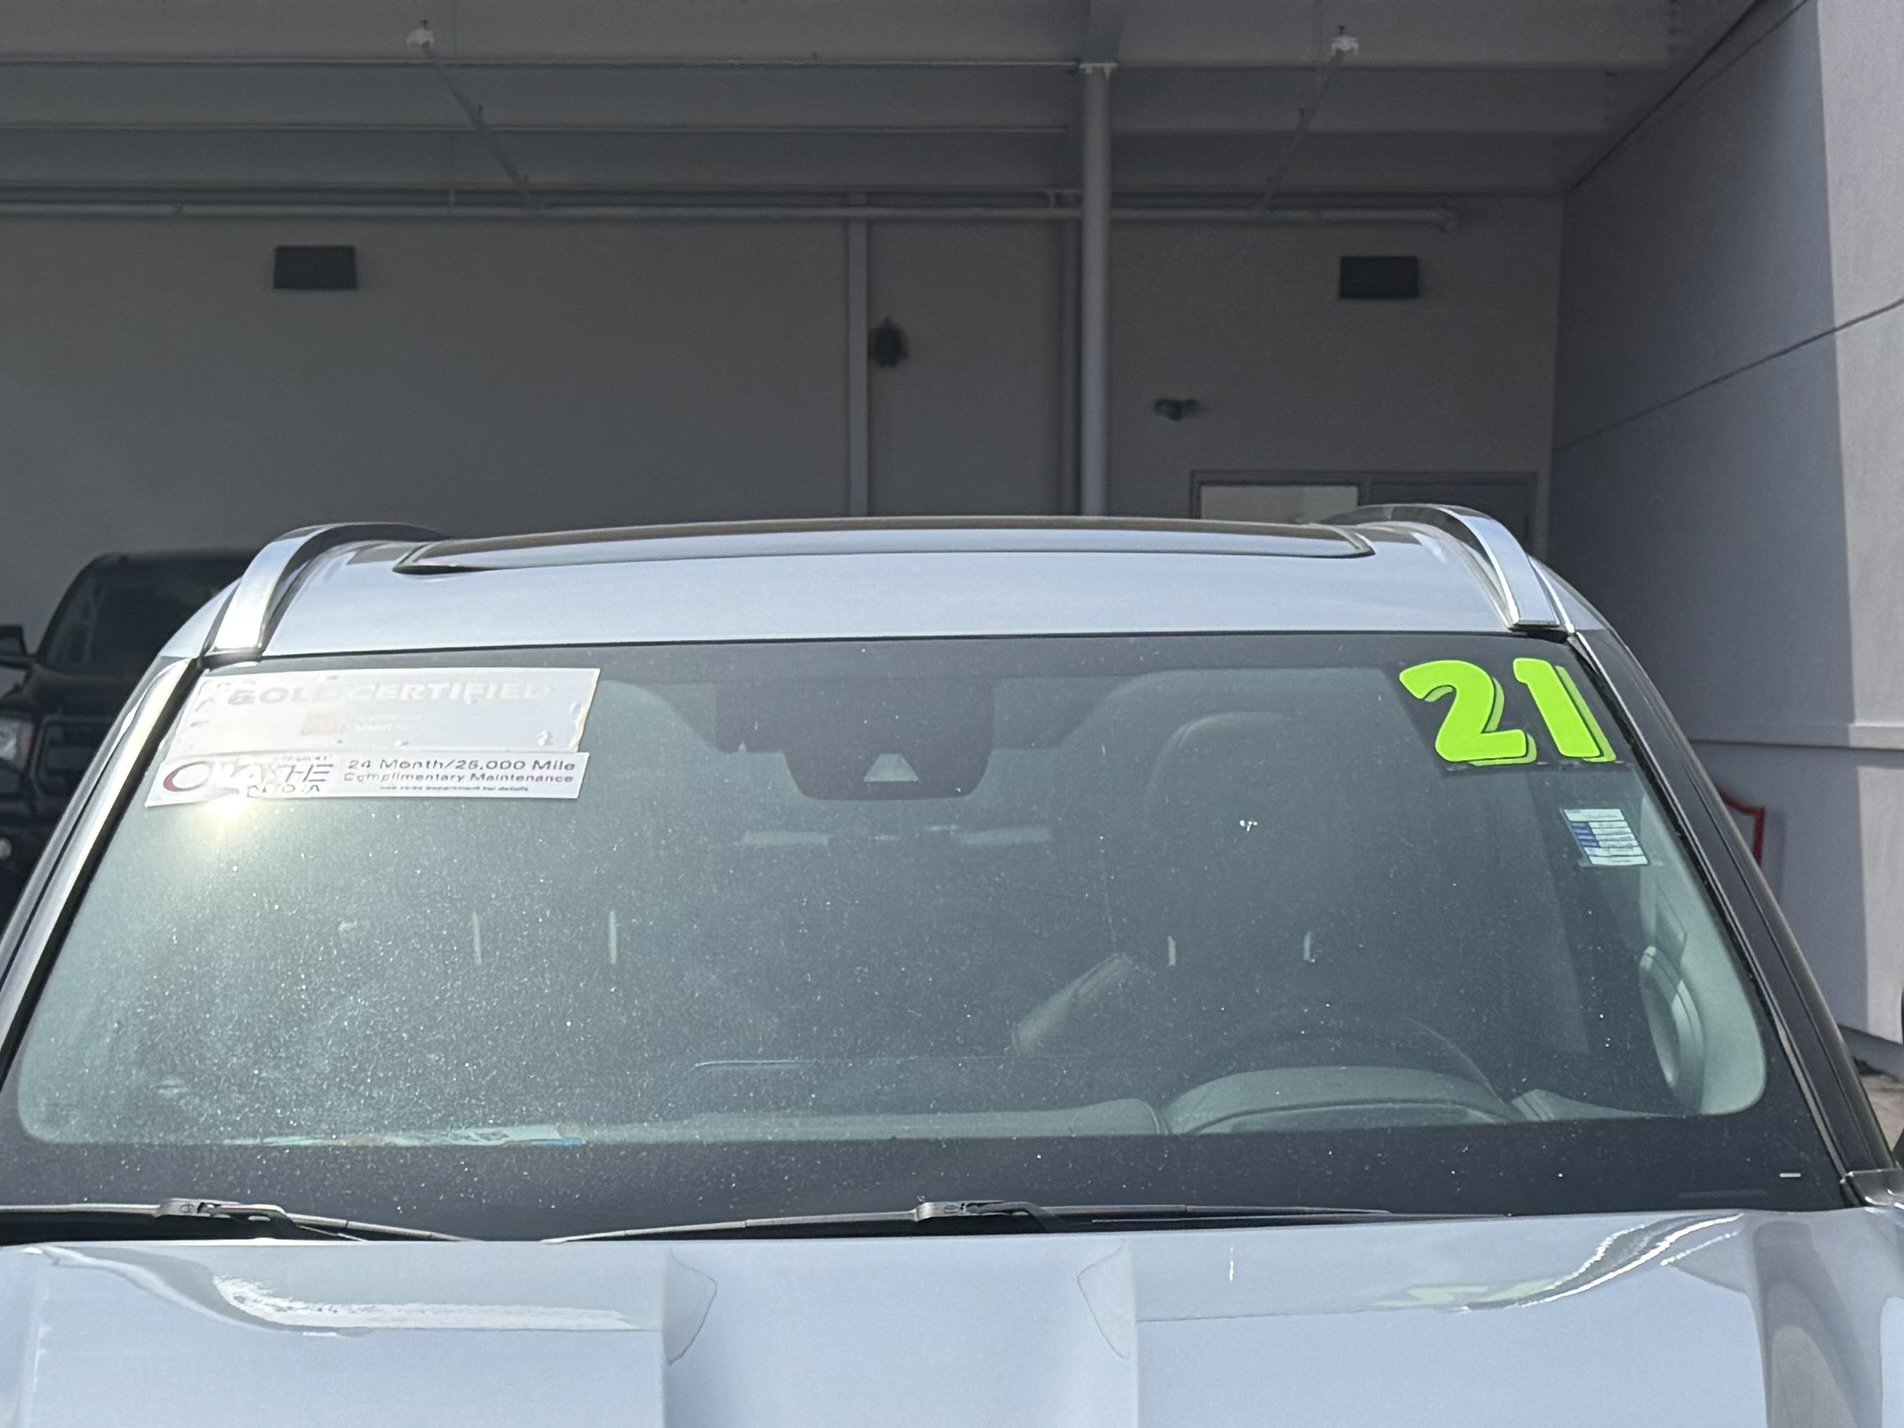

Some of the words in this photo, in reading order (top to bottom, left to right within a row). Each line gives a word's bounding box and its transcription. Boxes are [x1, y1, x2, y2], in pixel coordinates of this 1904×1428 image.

[352, 682, 551, 702] CERTIFIED
[1399, 658, 1615, 765] 21
[532, 759, 576, 772] Mile
[470, 772, 574, 784] Maintenance
